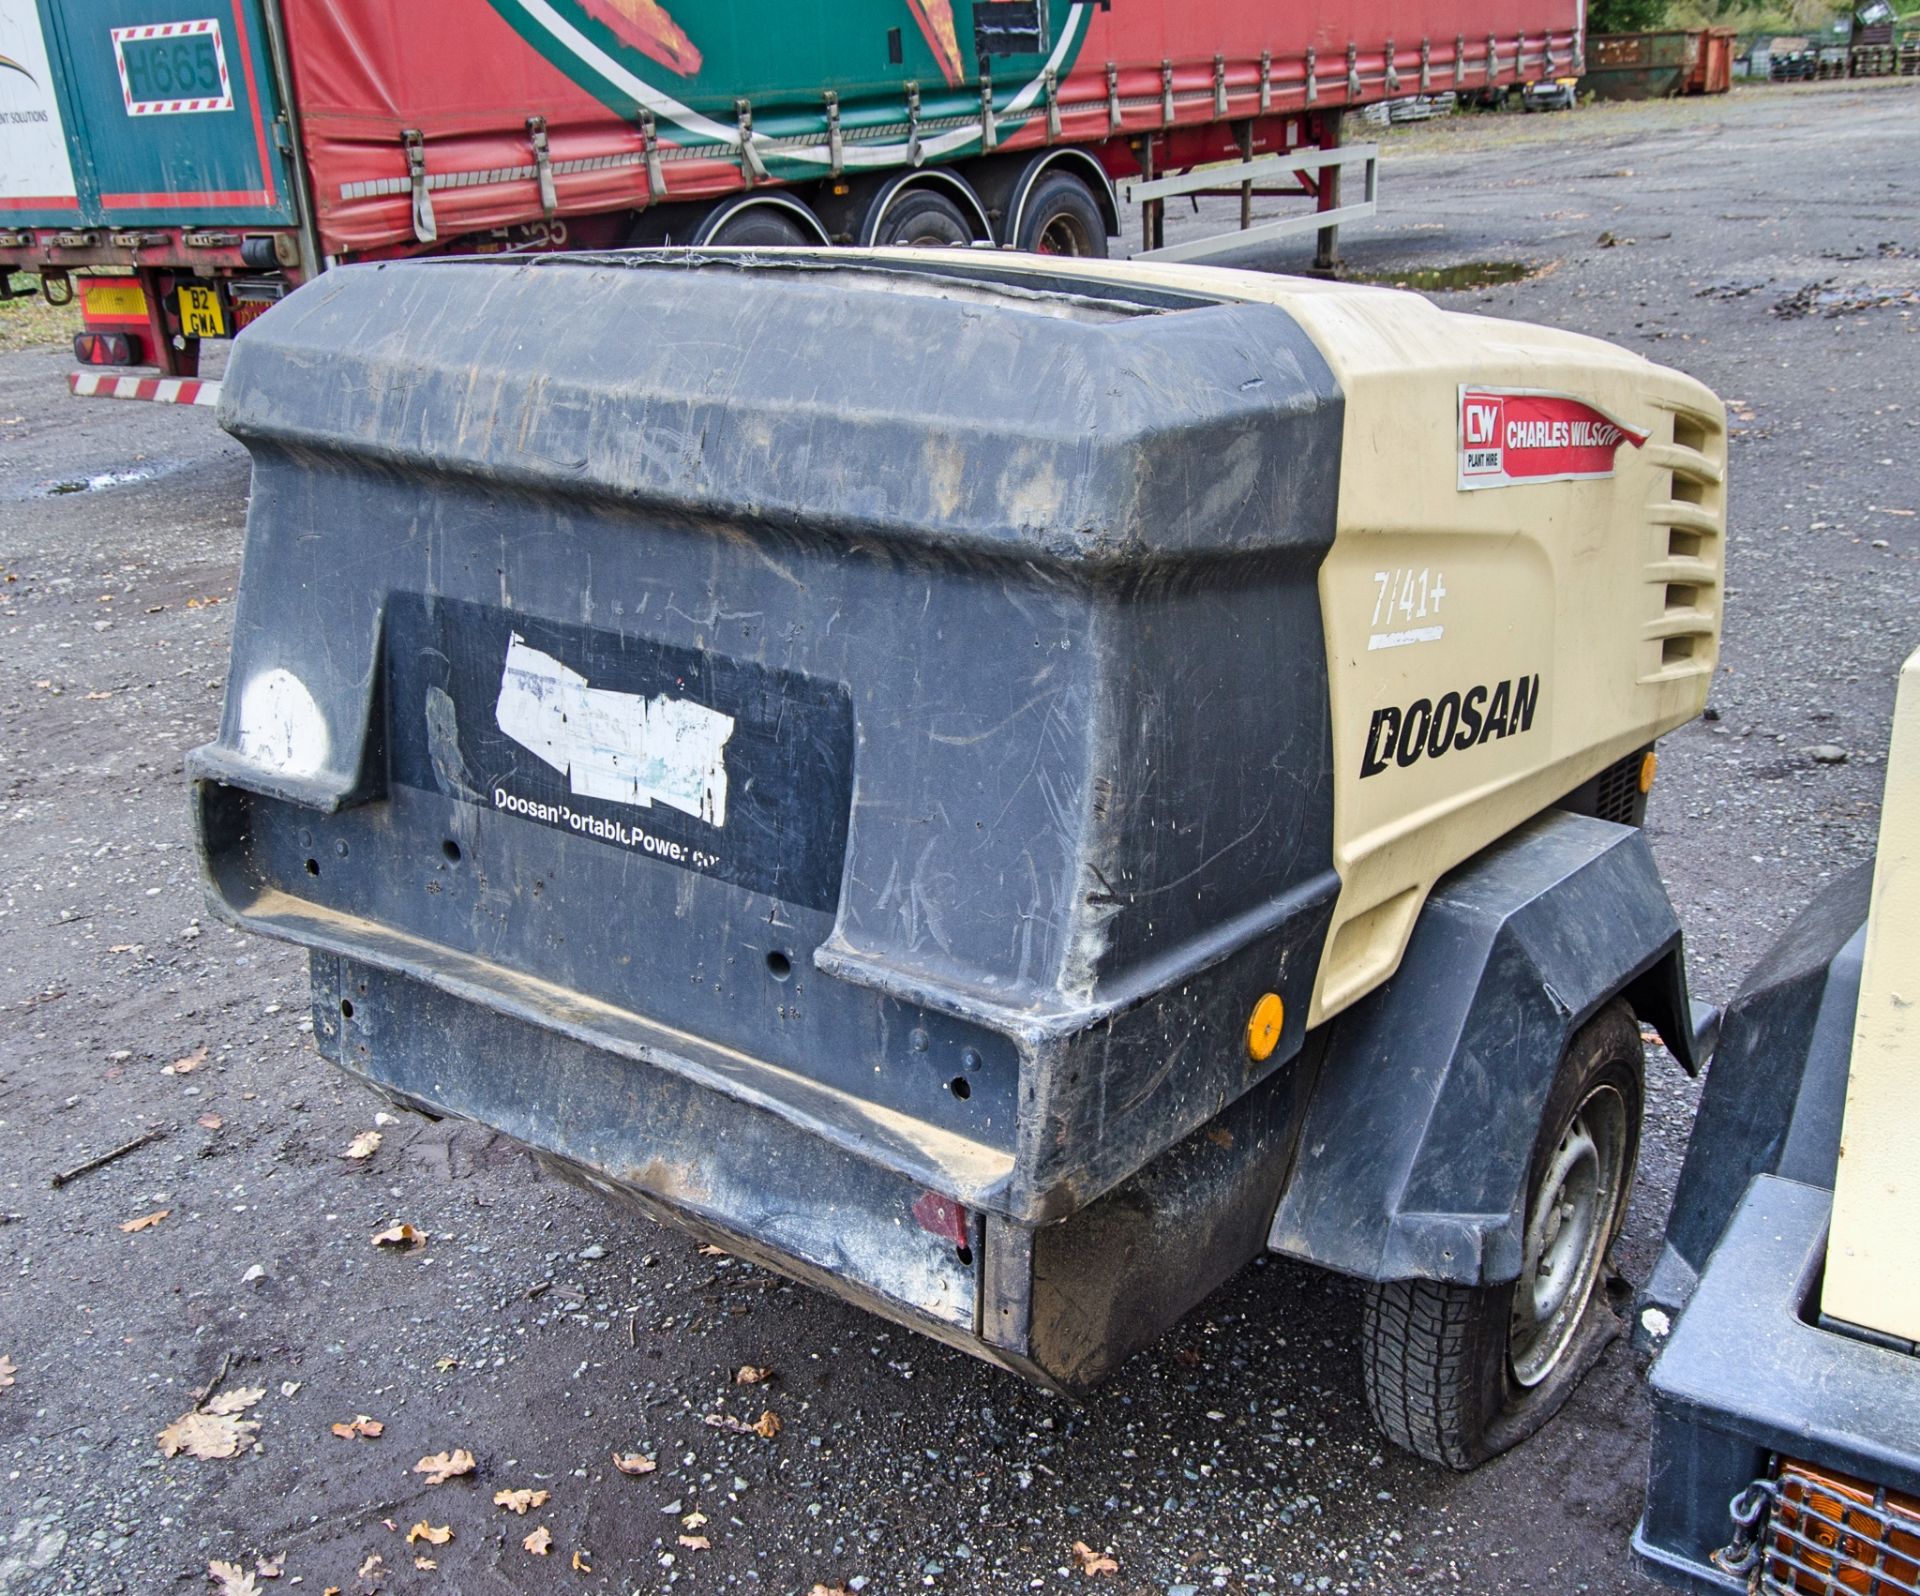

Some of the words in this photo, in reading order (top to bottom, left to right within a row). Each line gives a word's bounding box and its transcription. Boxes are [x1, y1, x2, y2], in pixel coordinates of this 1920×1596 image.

[125, 42, 217, 95] H665
[11, 109, 48, 124] SOLUTIONS
[191, 290, 210, 311] B2
[190, 314, 217, 334] GWA
[1466, 404, 1498, 444] CW
[1507, 421, 1569, 448] CHARLES
[1571, 421, 1622, 446] WILSON
[1467, 453, 1485, 467] PLANT
[1485, 453, 1498, 466] HIRE
[1371, 567, 1447, 626] 7/41+
[1359, 673, 1540, 779] DOOSAN
